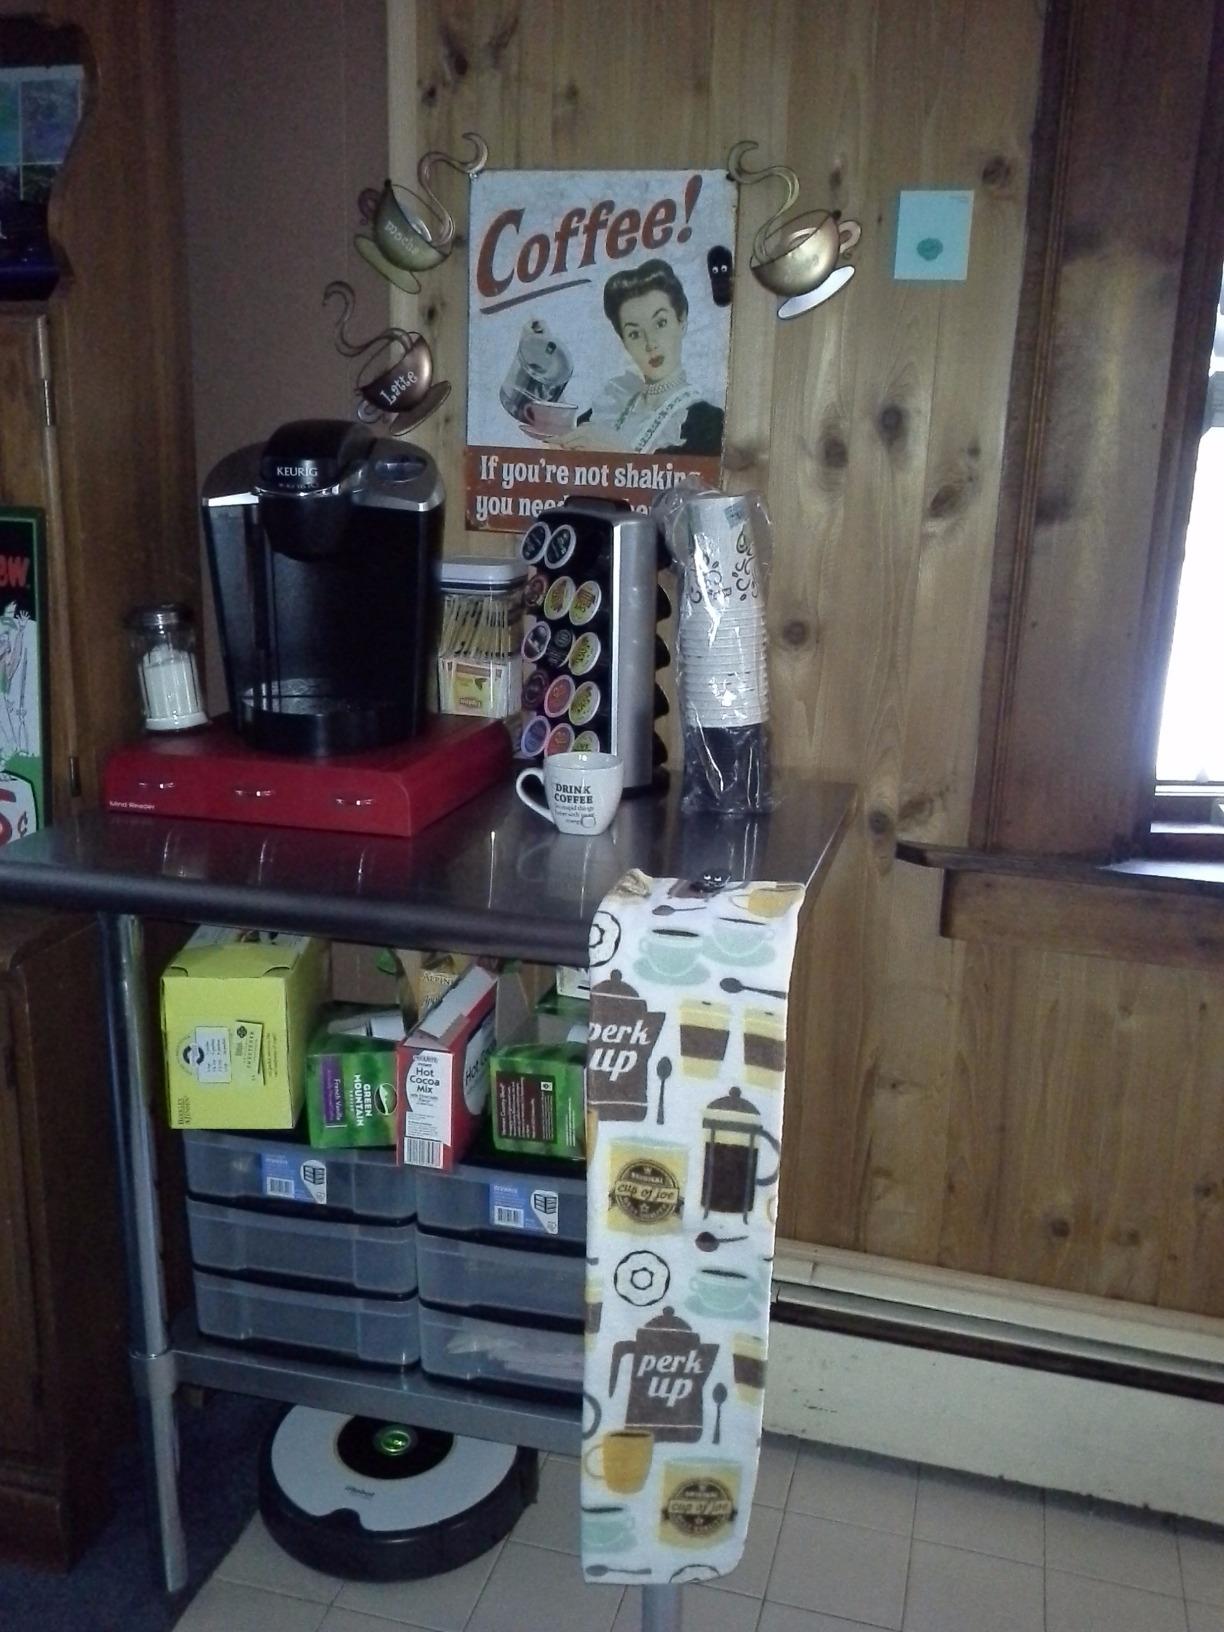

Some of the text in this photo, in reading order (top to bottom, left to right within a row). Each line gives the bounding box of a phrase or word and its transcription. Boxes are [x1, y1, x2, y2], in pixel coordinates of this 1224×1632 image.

[476, 175, 702, 297] Coffee!
[380, 371, 418, 405] Latte
[276, 466, 318, 477] KEURIG
[480, 455, 701, 490] If you're not shakin
[476, 495, 513, 521] you
[554, 792, 593, 804] COFFEE
[555, 783, 591, 795] DRINK
[416, 1067, 434, 1077] Hot
[589, 1049, 637, 1082] up
[333, 1078, 341, 1101] French
[409, 1074, 440, 1086] Cocoa
[417, 1085, 433, 1093] Mix
[353, 1074, 364, 1127] MOUNTAIN
[363, 1083, 373, 1117] GREEN
[637, 1349, 704, 1377] perk
[648, 1377, 693, 1407] up
